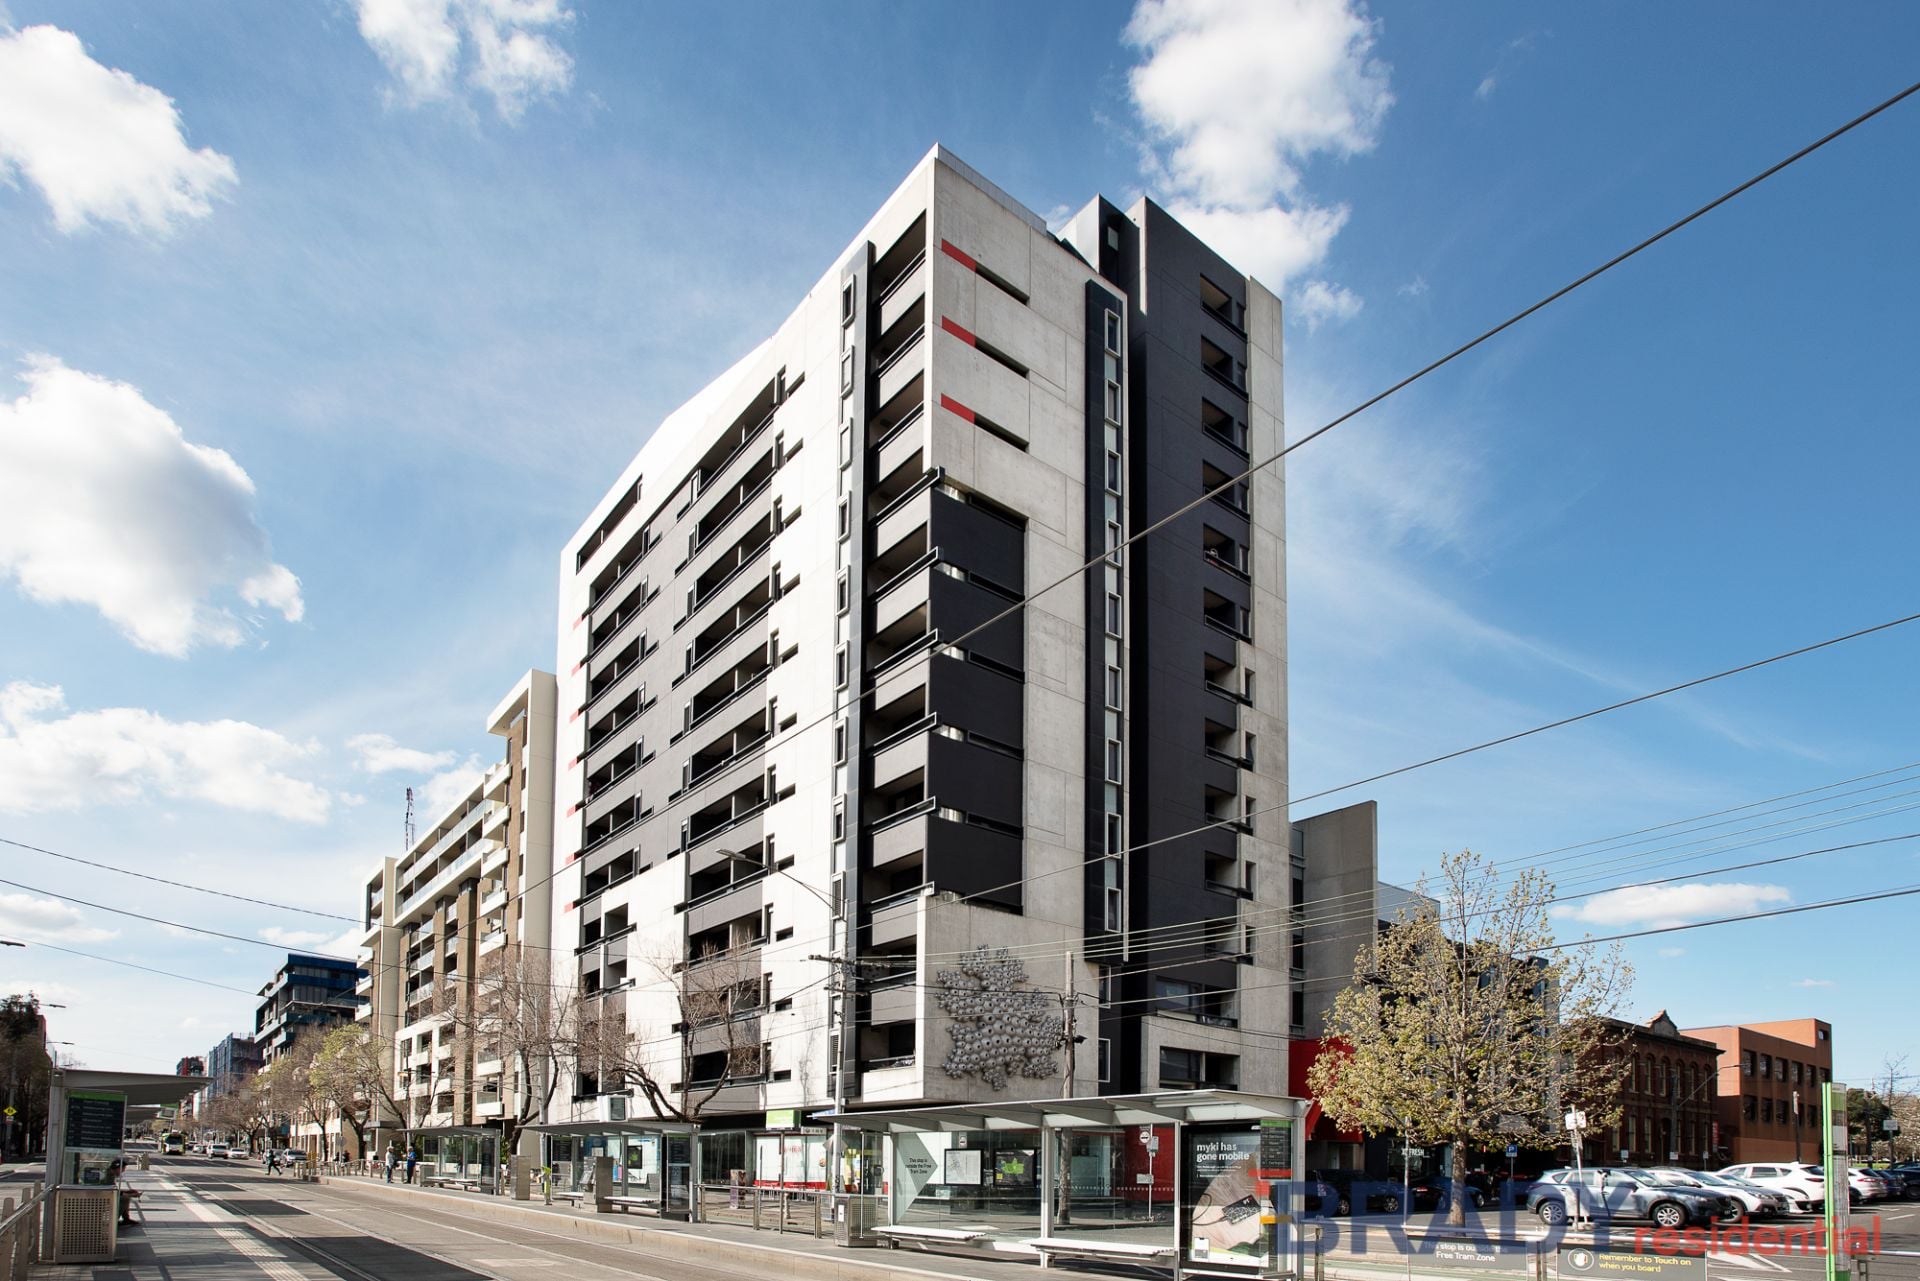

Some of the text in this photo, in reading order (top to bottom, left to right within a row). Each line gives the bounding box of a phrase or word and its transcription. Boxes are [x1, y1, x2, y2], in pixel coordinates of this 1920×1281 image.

[1196, 1142, 1237, 1153] myki has
[1196, 1151, 1250, 1163] gone mobile
[1440, 1243, 1456, 1252] stop
[1457, 1243, 1465, 1251] is
[1436, 1251, 1496, 1262] Free Tram Zone
[1599, 1254, 1641, 1263] Remember
[1644, 1256, 1653, 1264] to
[1654, 1256, 1679, 1265] Touch
[1599, 1261, 1662, 1273] when you board
